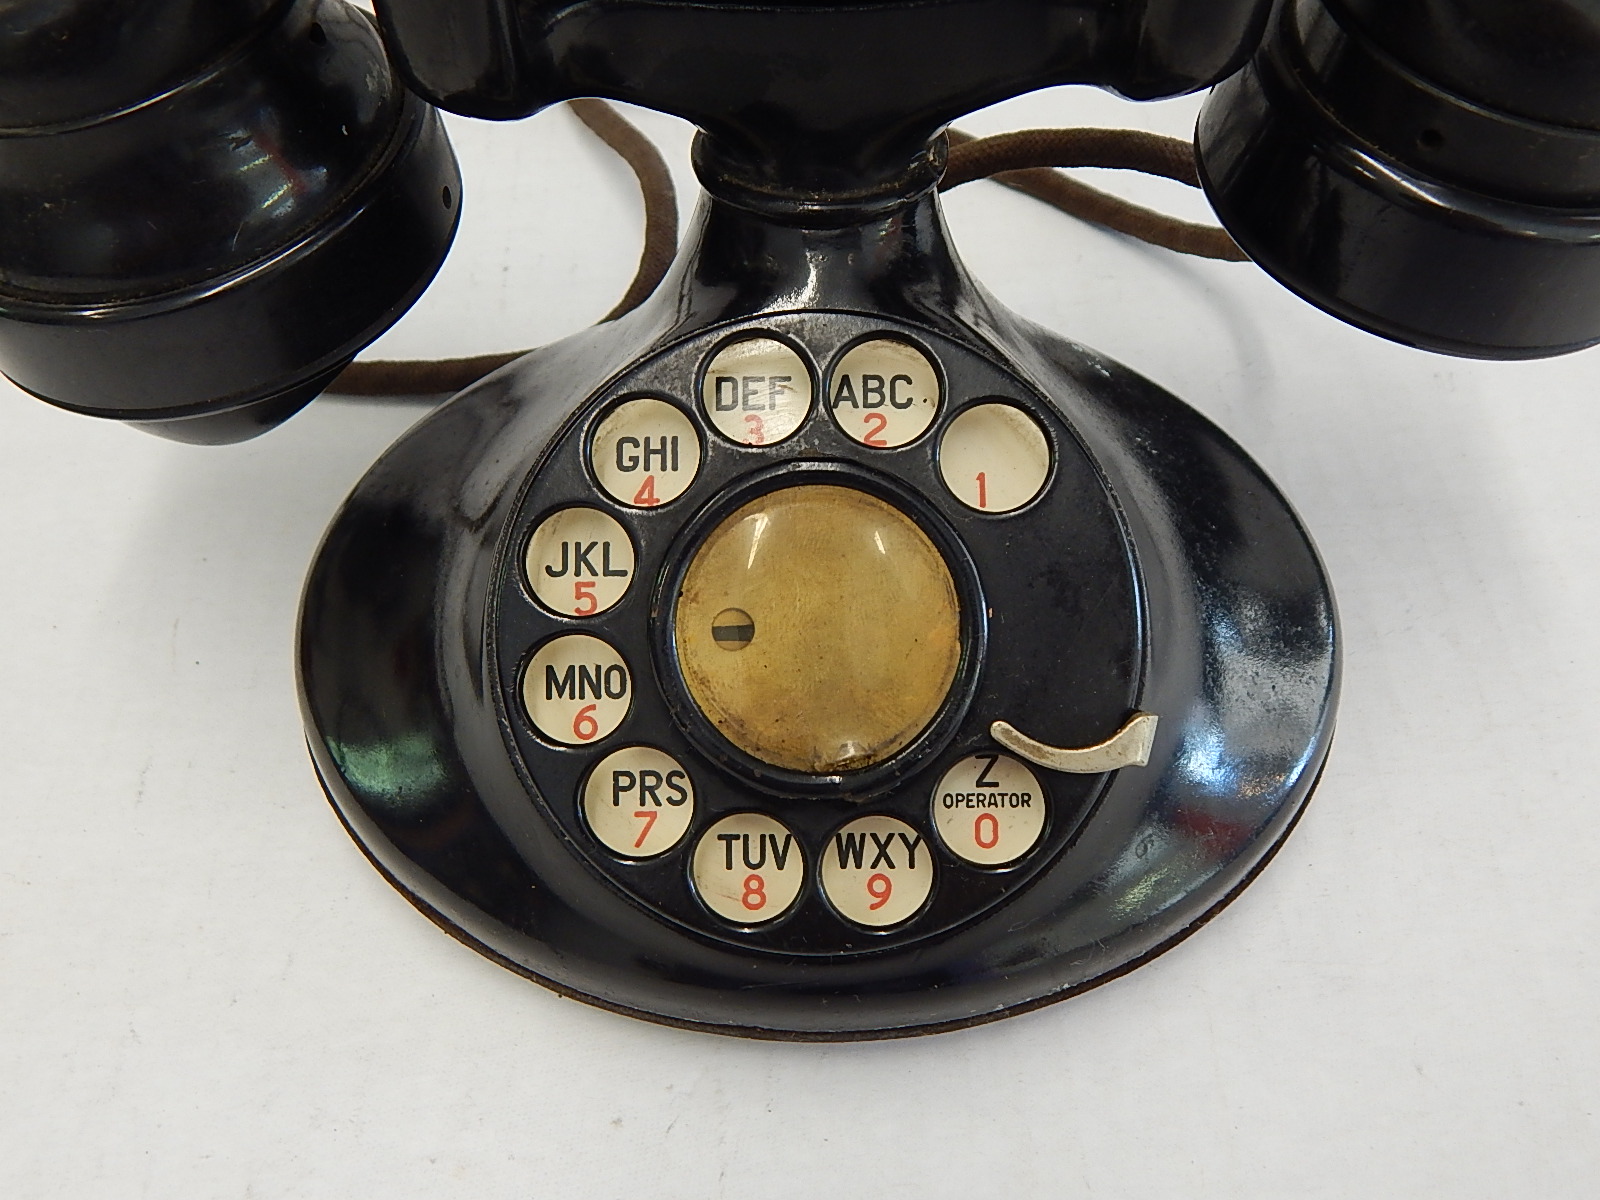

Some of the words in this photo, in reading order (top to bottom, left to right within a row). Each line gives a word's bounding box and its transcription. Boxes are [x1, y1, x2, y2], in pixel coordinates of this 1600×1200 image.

[715, 376, 792, 411] DEF
[832, 374, 913, 409] ABC
[742, 414, 765, 445] 3
[863, 412, 887, 446] 2
[616, 436, 679, 472] GHI
[633, 475, 660, 506] 4
[975, 472, 987, 508] 1
[544, 541, 628, 577] JKL
[574, 581, 598, 616] 5
[545, 664, 627, 700] MNO
[573, 704, 598, 740] 6
[612, 770, 688, 807] PRS
[974, 755, 1000, 788] Z
[942, 792, 1032, 809] OPERATOR
[634, 811, 657, 848] 7
[974, 813, 999, 849] 0
[717, 834, 792, 870] TUV
[836, 833, 922, 869] WXY
[742, 874, 767, 910] 8
[867, 873, 892, 910] 9
